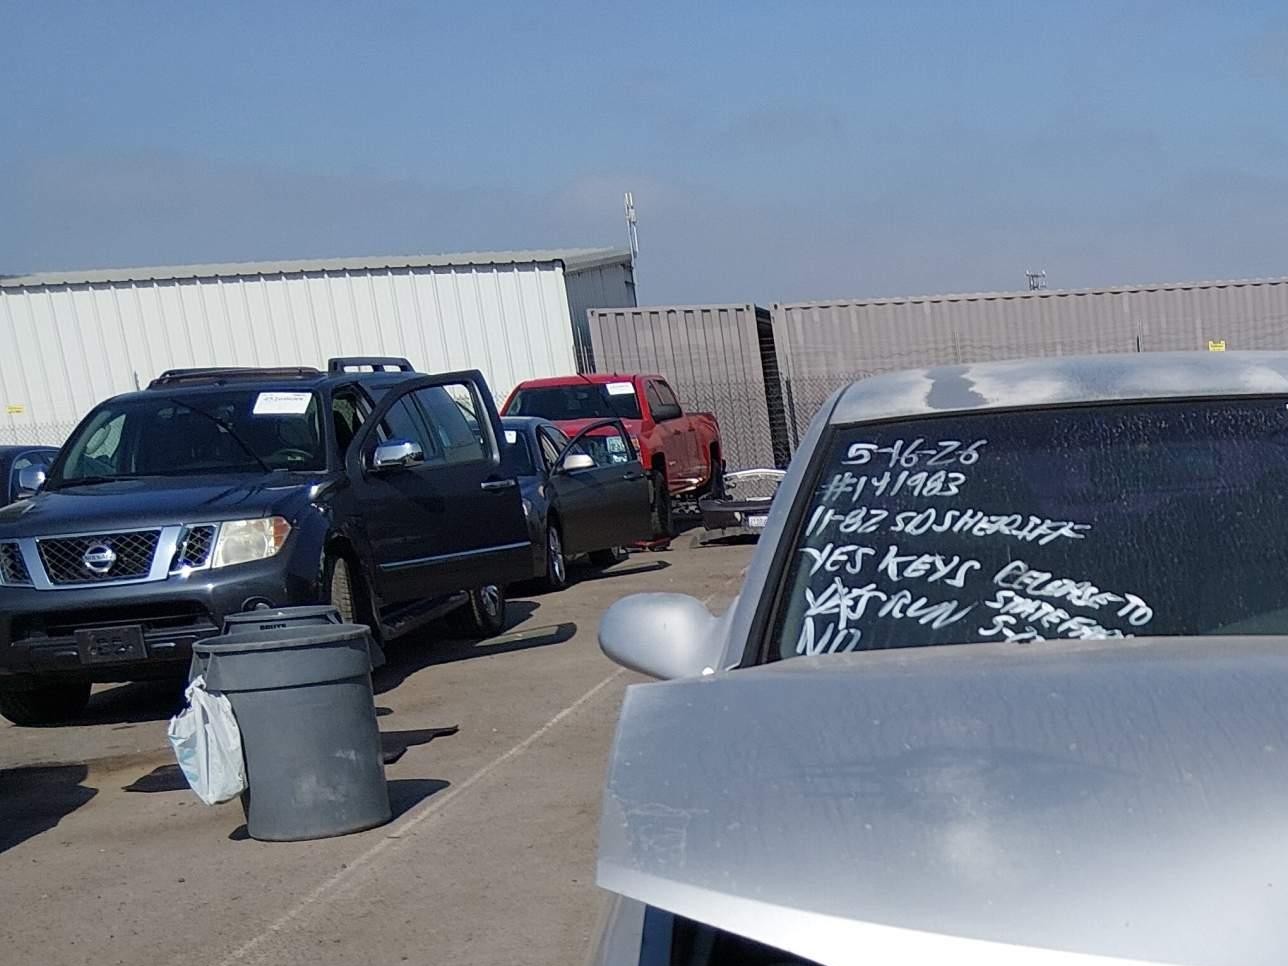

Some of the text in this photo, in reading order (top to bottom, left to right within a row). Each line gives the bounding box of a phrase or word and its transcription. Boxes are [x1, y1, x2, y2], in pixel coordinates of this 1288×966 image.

[841, 438, 988, 468] 5-16-26
[821, 470, 967, 502] #141983
[800, 543, 981, 588] YES KEYS
[877, 589, 981, 630] RUN
